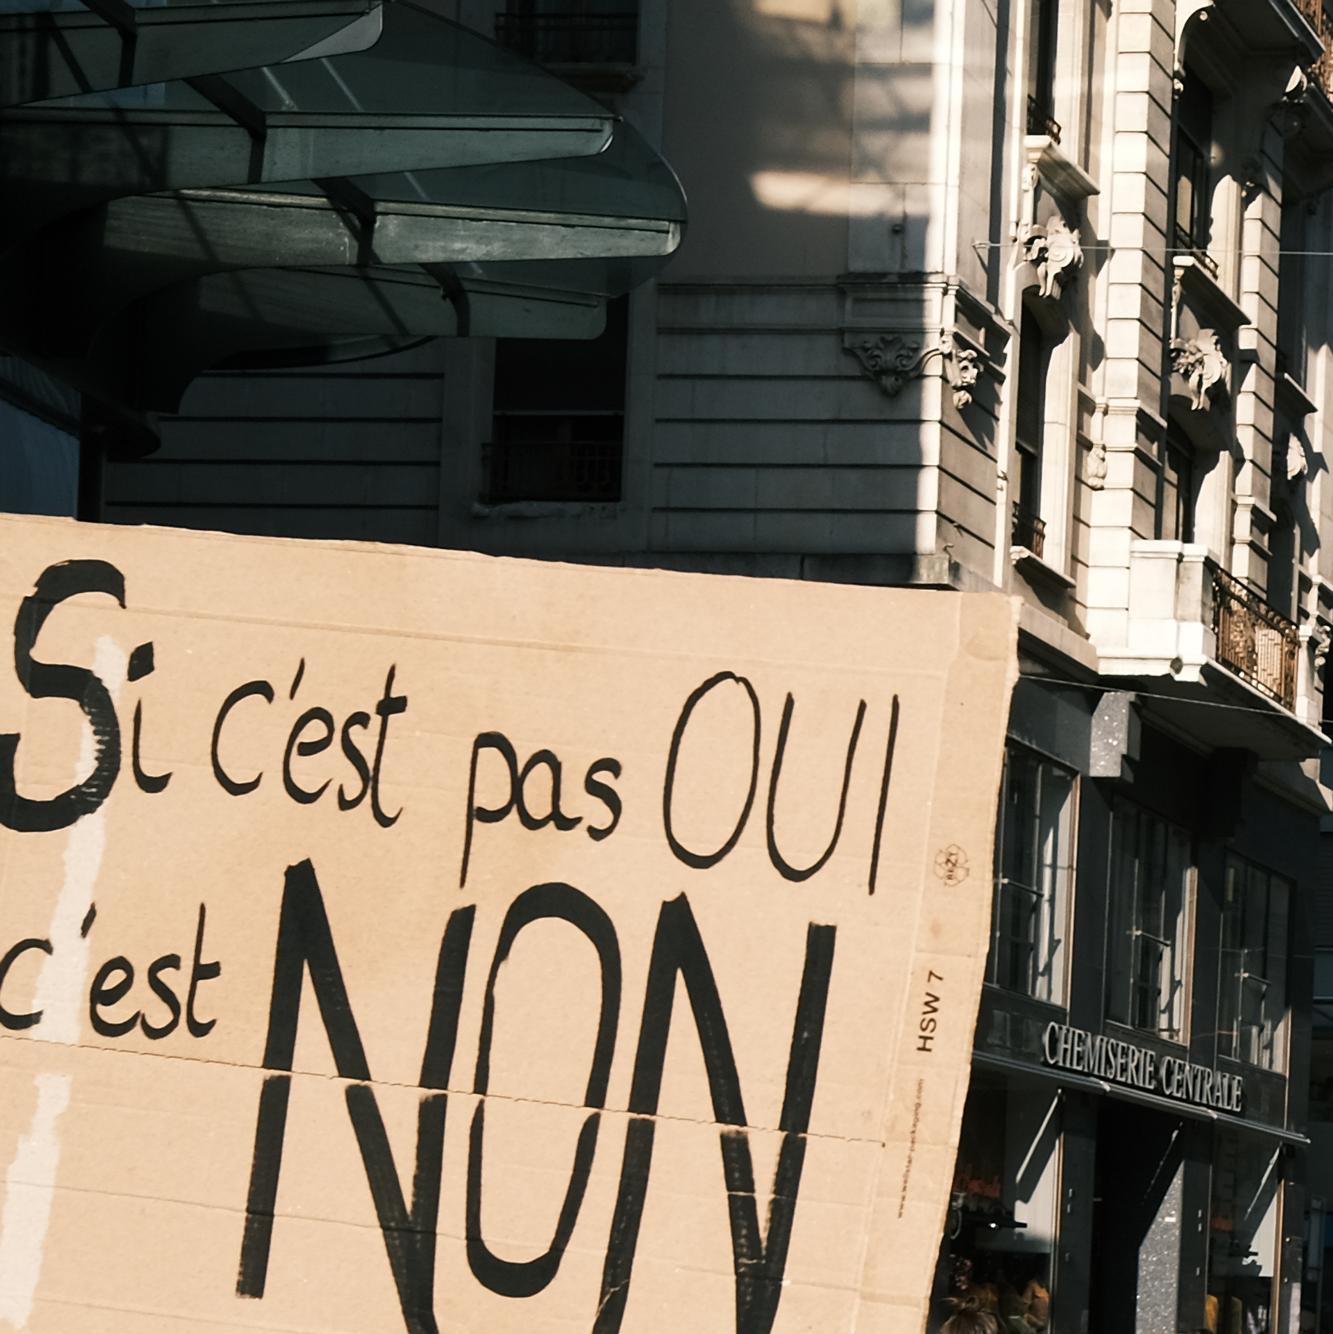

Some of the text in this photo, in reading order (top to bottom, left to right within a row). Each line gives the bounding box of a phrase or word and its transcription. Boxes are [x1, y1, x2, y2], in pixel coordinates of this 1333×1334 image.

[0, 558, 900, 896] Si c'est pas OUI
[0, 902, 221, 1040] c'est
[916, 970, 944, 1053] HSW 7
[1044, 1022, 1243, 1113] CHEMISERIE CENTRALE
